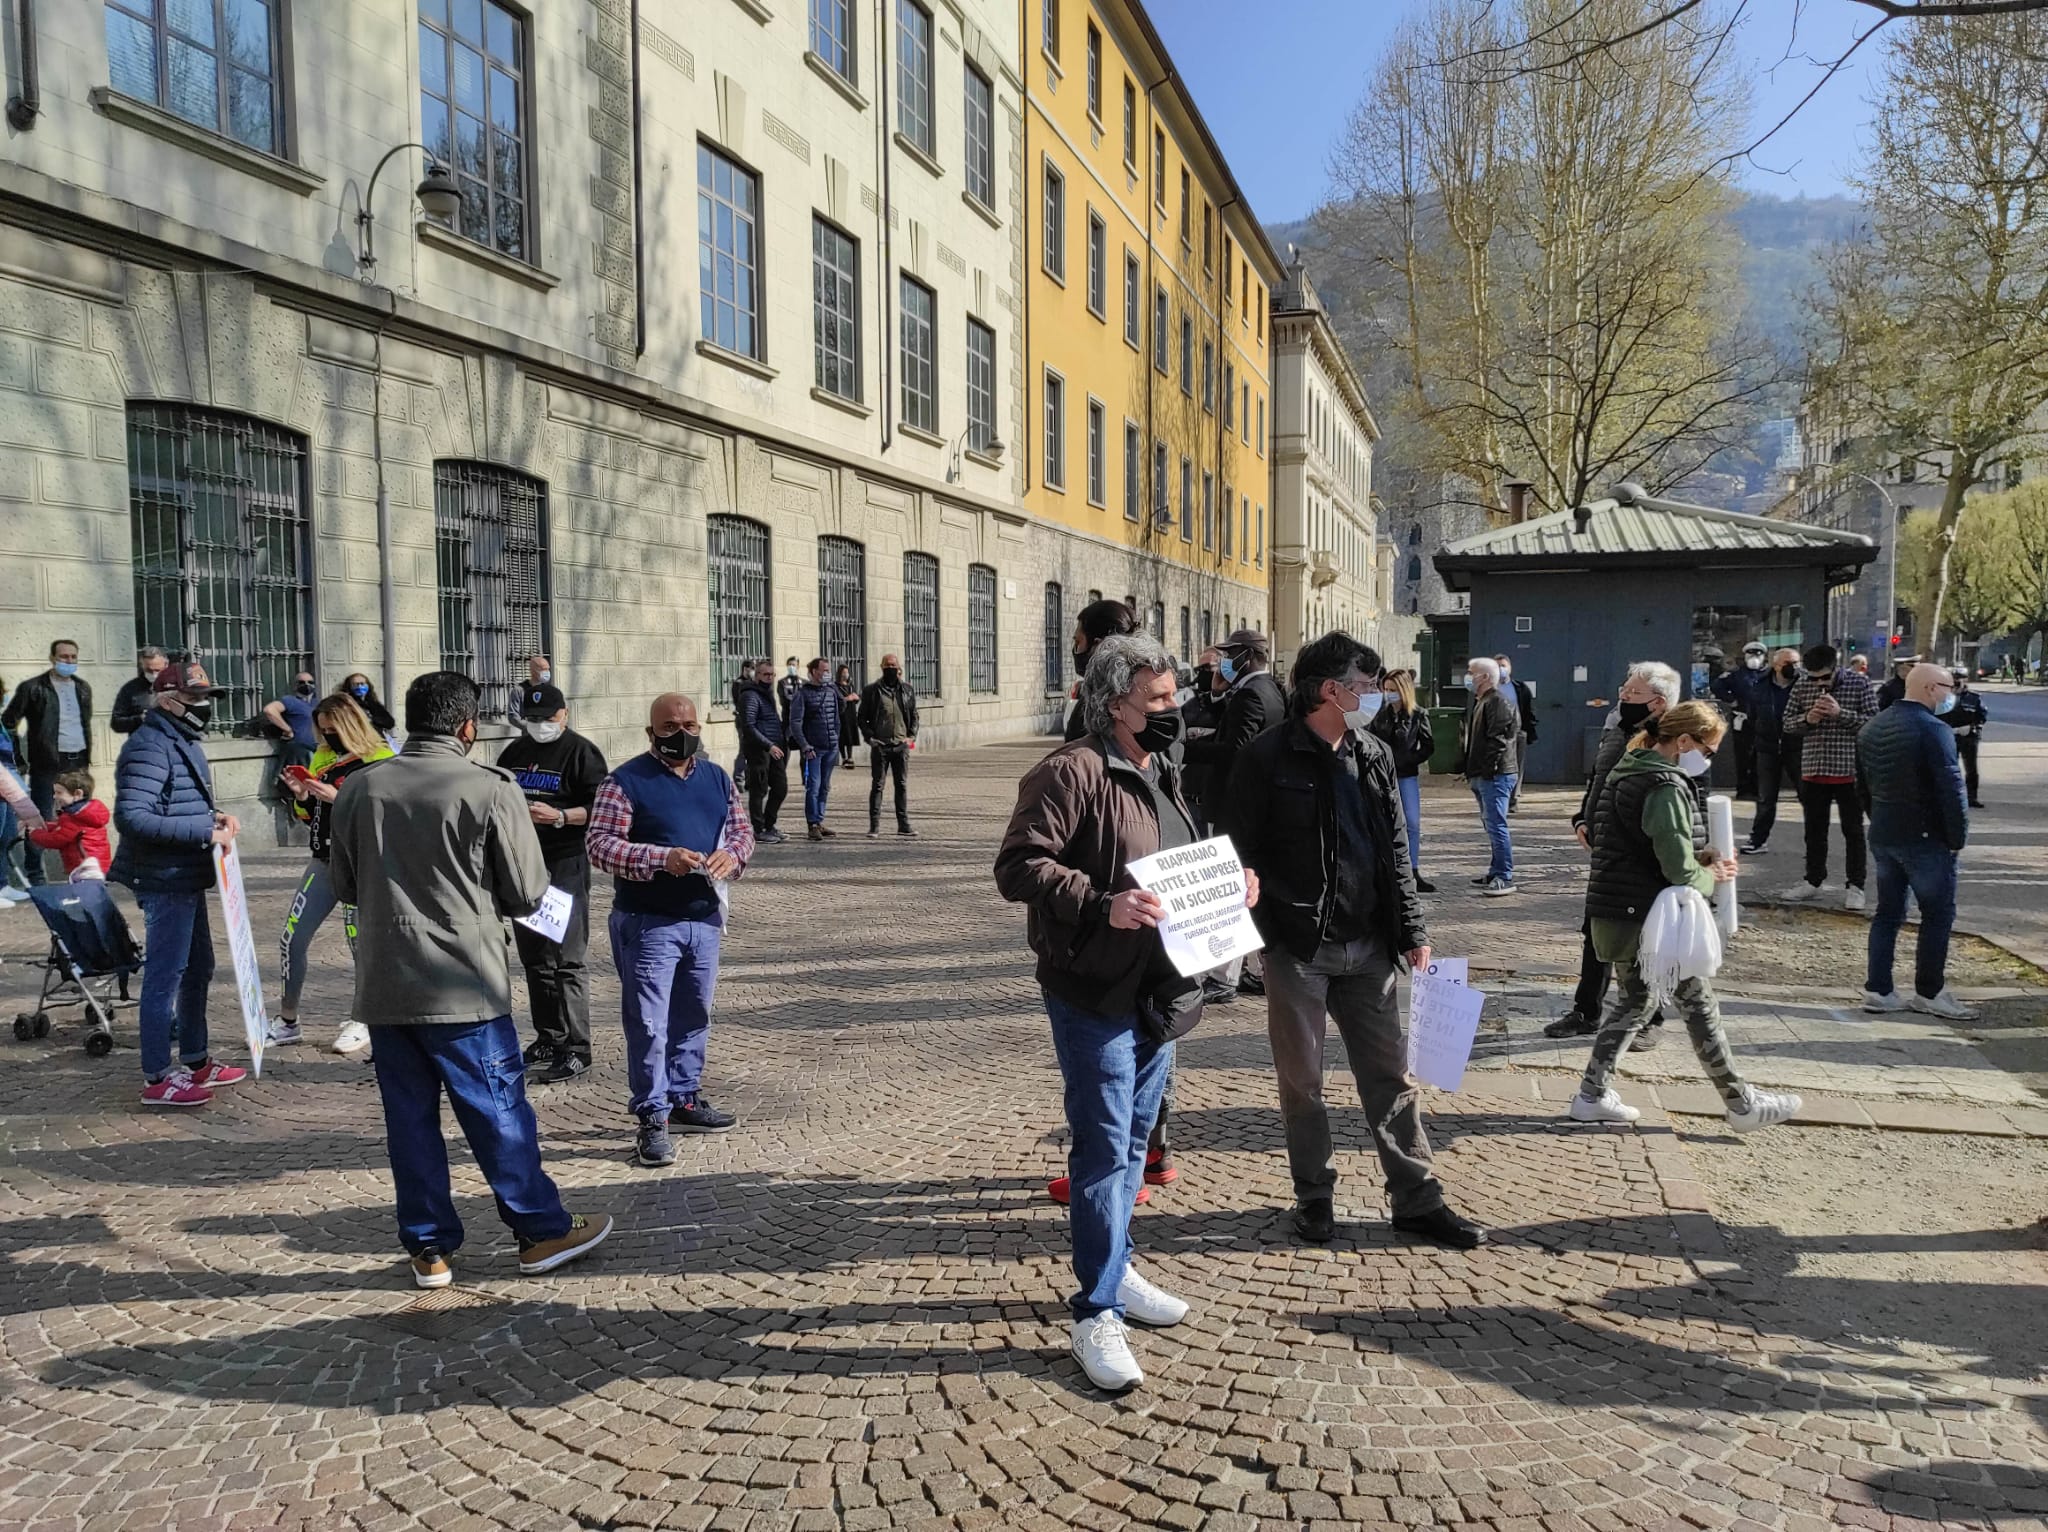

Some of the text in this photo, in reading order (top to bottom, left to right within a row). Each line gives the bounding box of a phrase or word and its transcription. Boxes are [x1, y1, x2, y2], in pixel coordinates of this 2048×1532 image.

[1156, 844, 1218, 871] RIAPRIAMO
[1147, 859, 1240, 896] TUTTE LE IMPRESE
[1169, 880, 1242, 913] IN SICUREZZA
